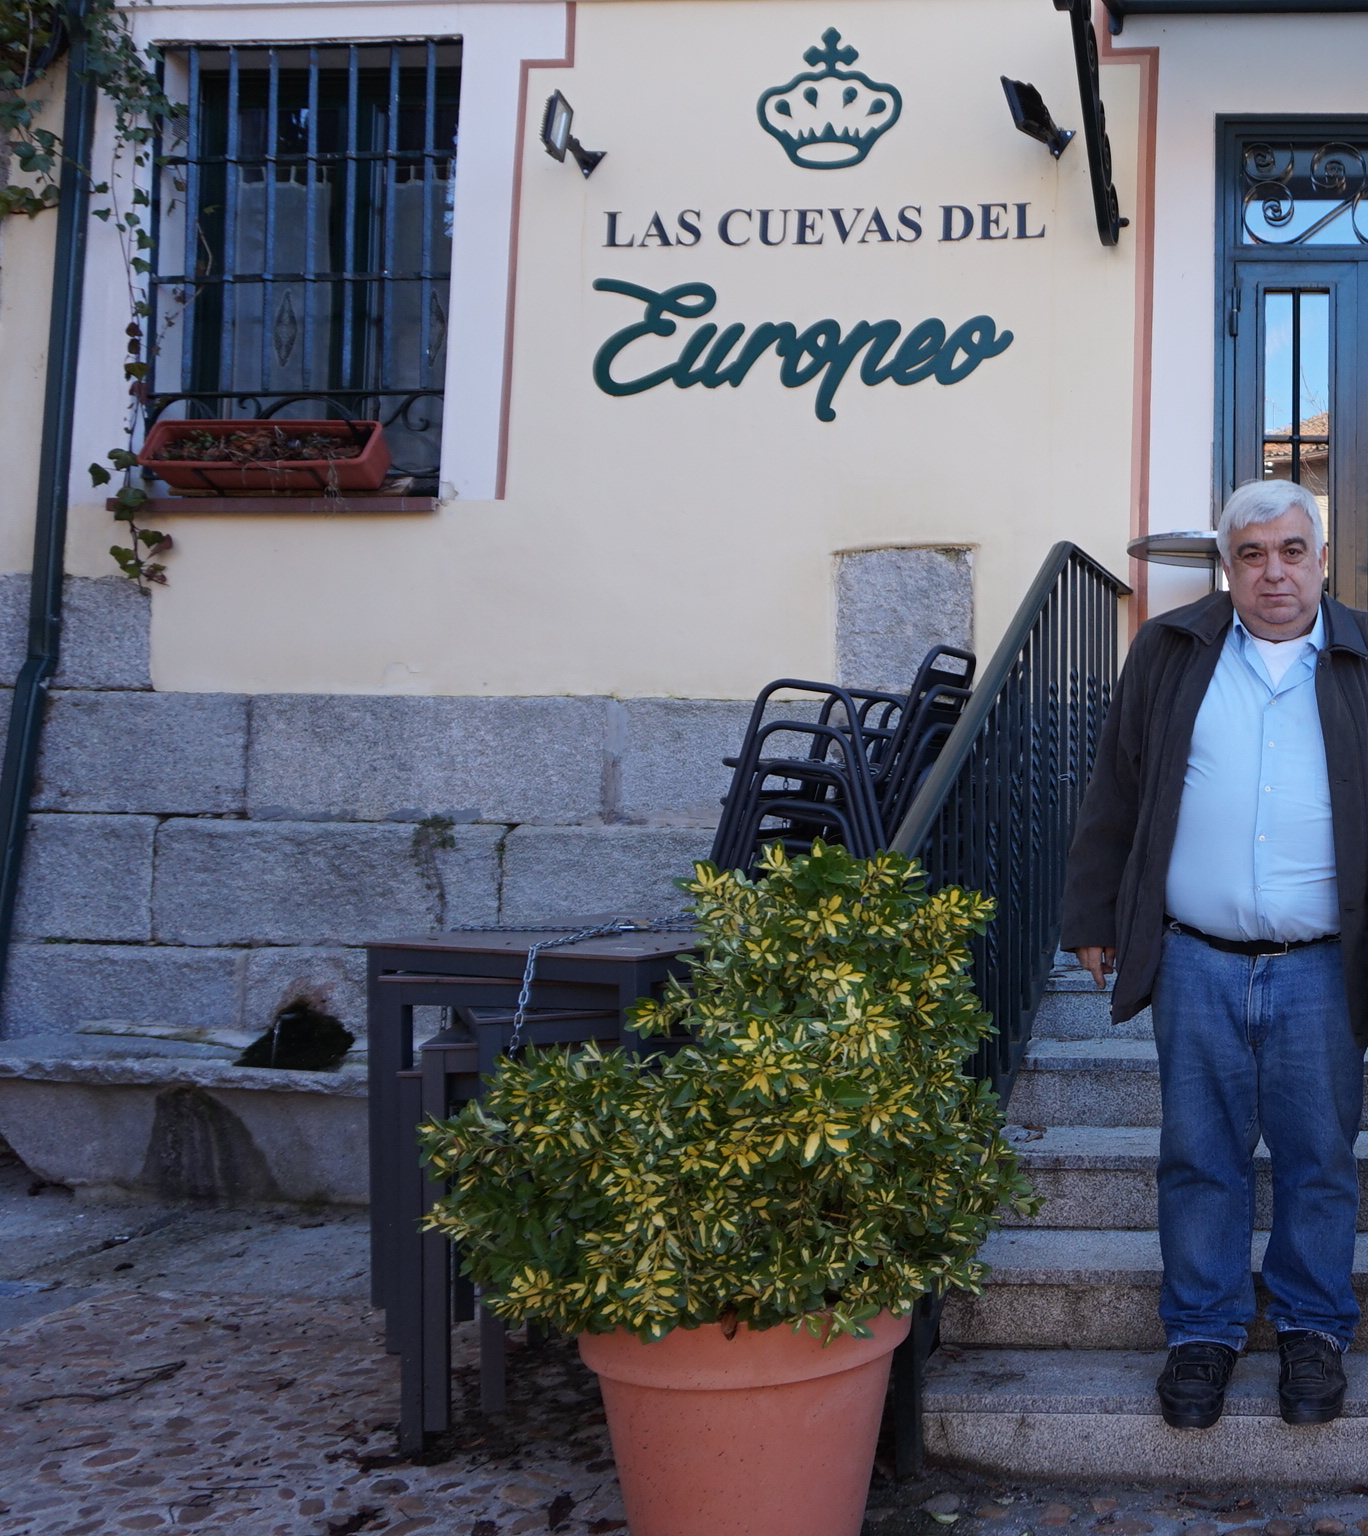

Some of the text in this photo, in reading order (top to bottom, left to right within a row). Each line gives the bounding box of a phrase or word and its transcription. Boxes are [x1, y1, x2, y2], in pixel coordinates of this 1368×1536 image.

[602, 202, 1046, 248] LAS CUEVAS DEL
[592, 277, 1014, 422] Europeo
